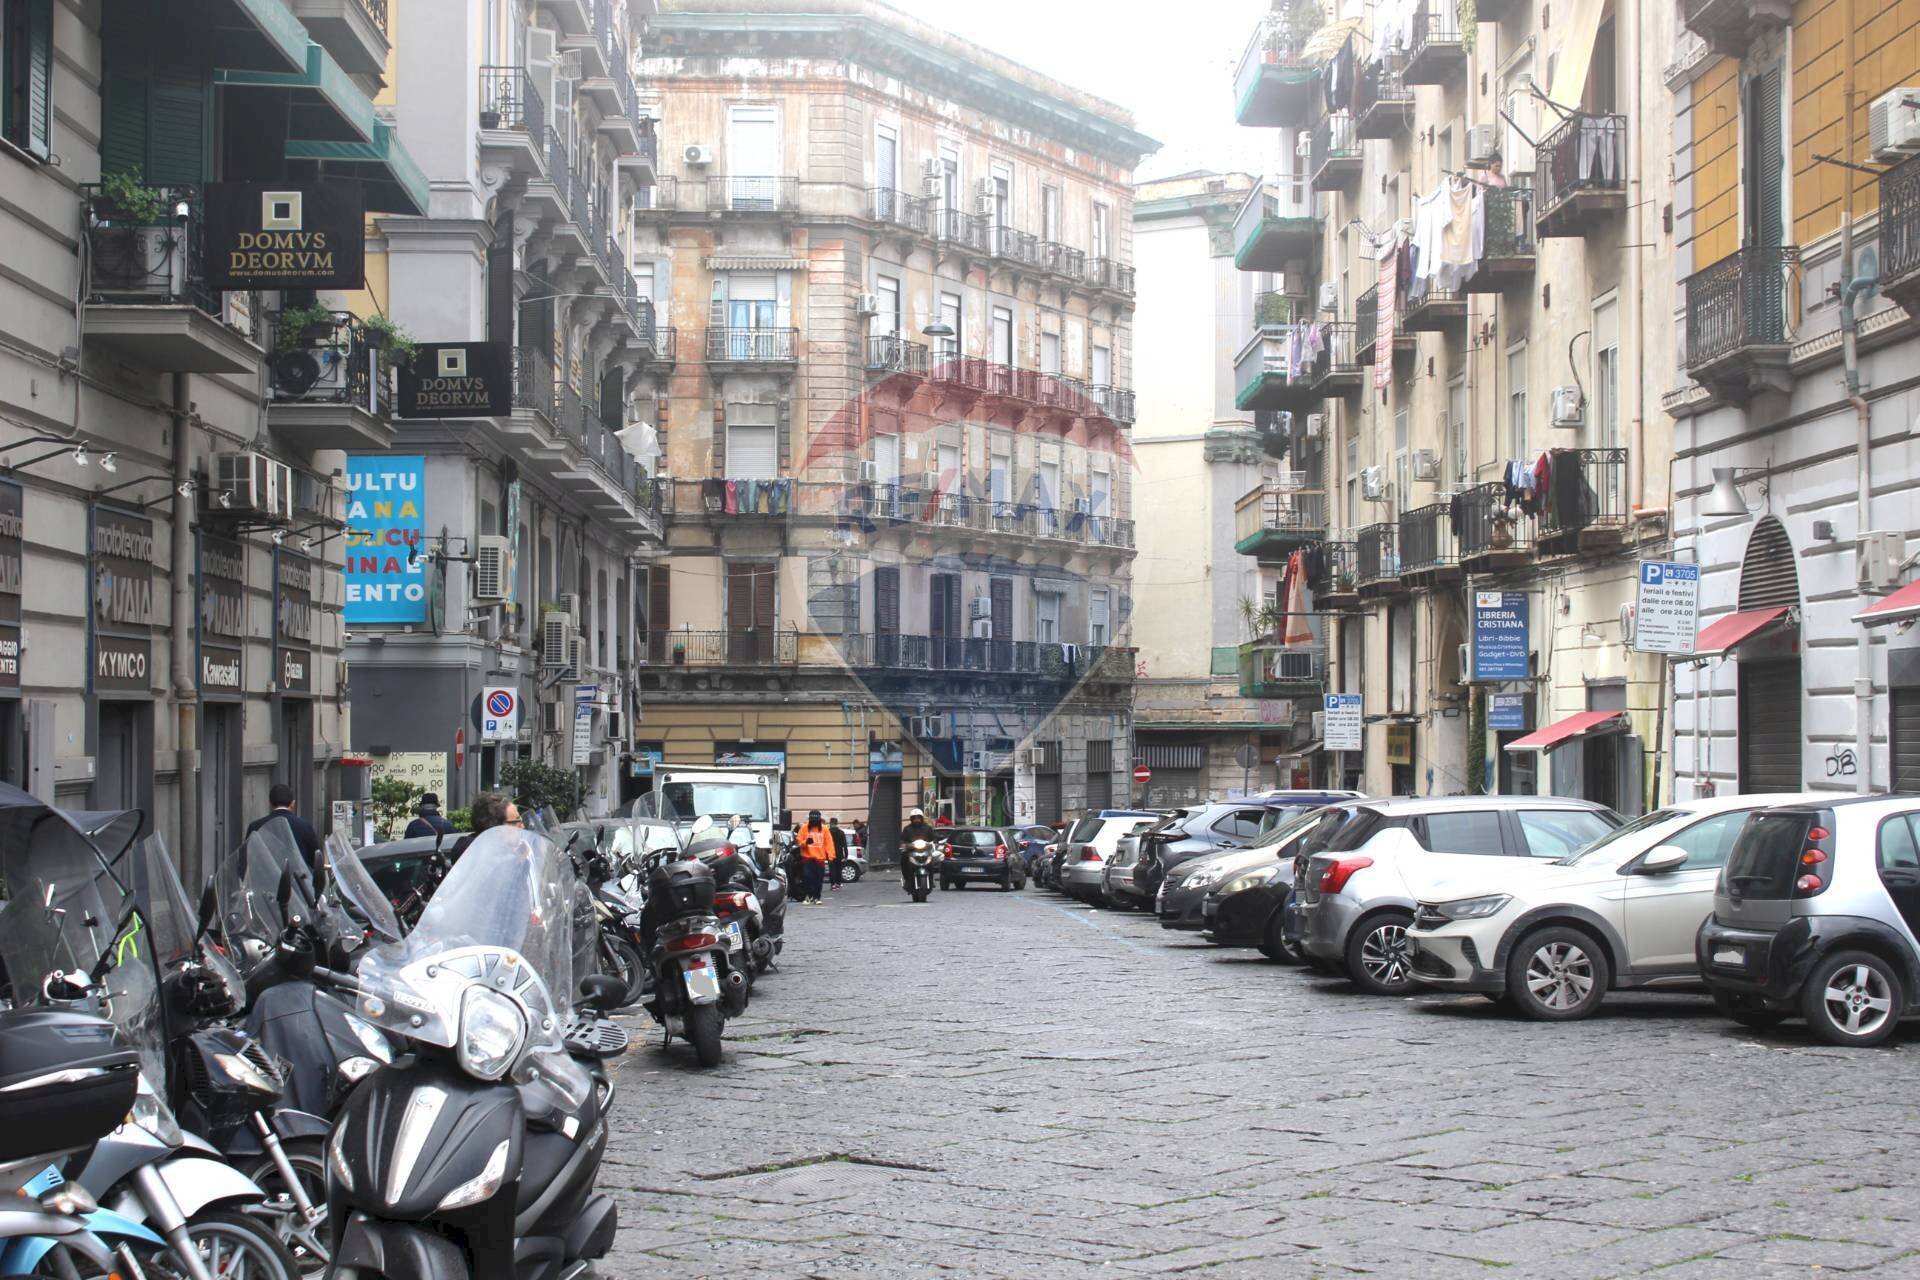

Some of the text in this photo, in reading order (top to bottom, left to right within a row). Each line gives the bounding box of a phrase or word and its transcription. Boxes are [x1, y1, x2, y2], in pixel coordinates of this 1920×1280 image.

[239, 232, 326, 249] DOMVS
[230, 251, 334, 269] DEORVM
[421, 377, 485, 391] DOMVS
[416, 391, 490, 405] DEORVM
[1675, 569, 1696, 579] 3705
[1674, 599, 1694, 607] 08.00
[1478, 611, 1516, 619] LIBRERIA
[1478, 620, 1524, 628] CRISTIANA
[99, 651, 146, 678] KYMCO
[203, 656, 239, 687] Kawasaki
